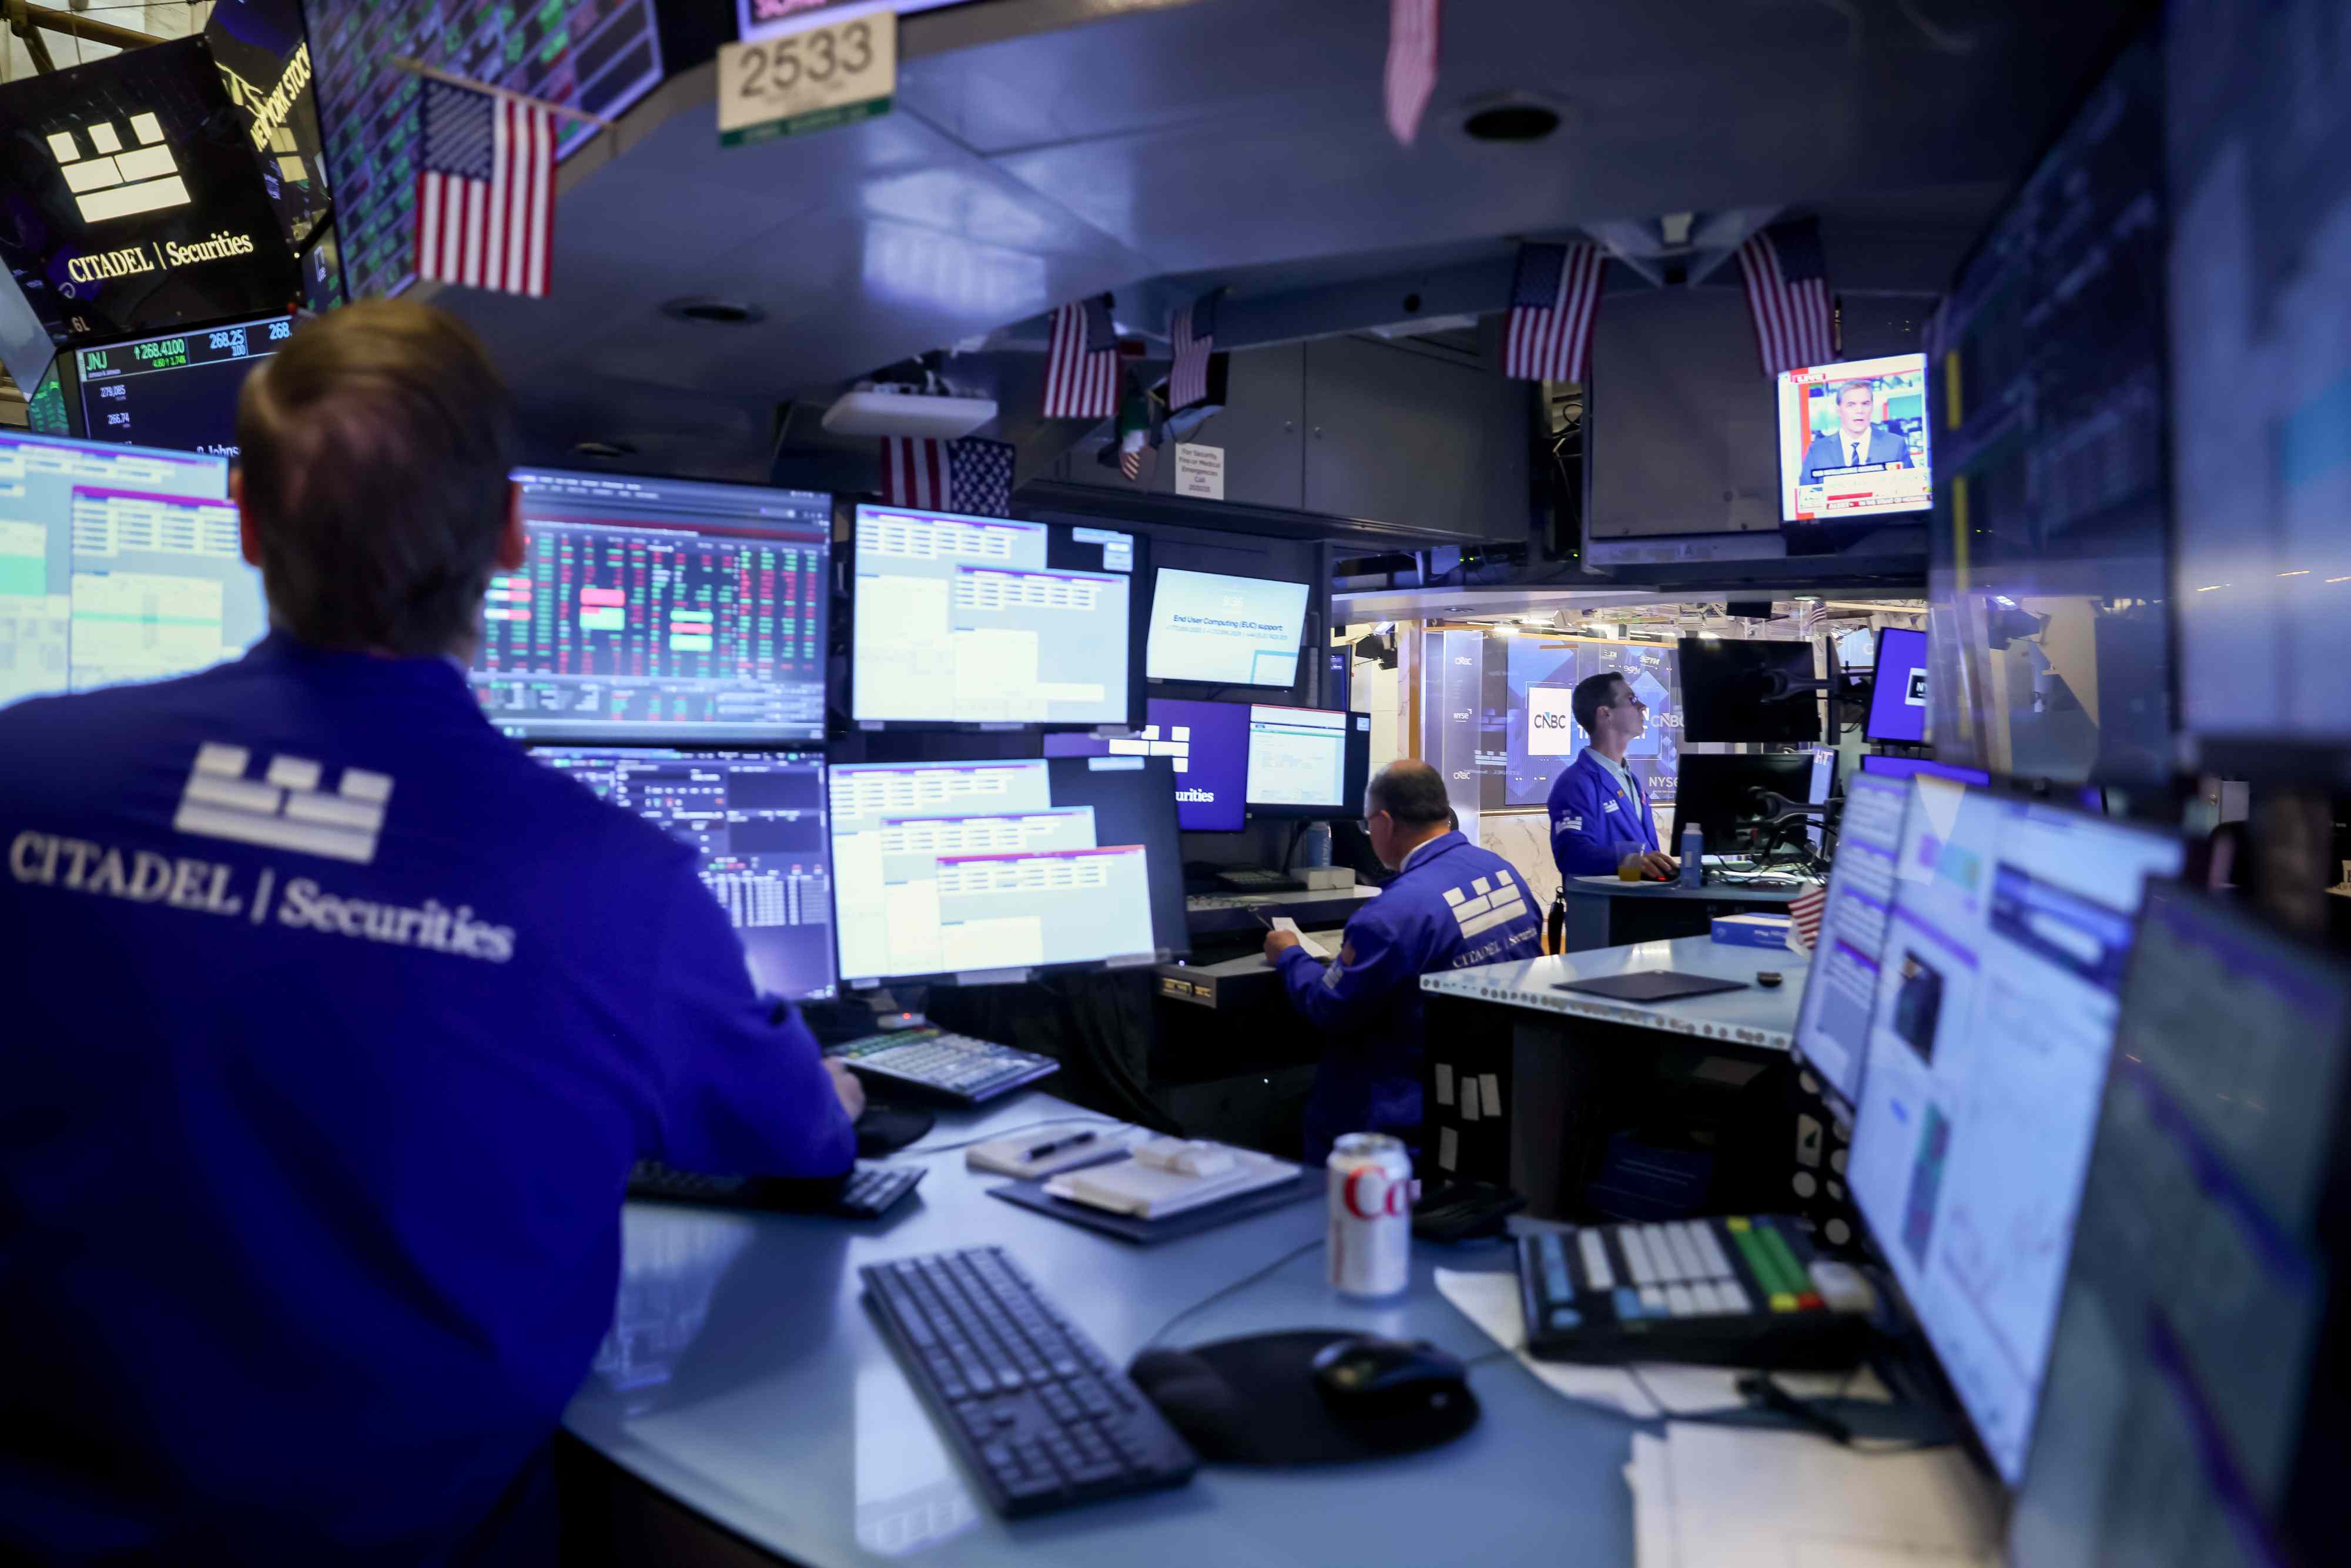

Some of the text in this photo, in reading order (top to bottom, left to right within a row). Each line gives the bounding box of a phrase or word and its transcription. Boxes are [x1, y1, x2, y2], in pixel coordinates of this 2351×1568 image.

[739, 21, 872, 98] 2533
[68, 246, 154, 283] CITADEL
[165, 230, 254, 267] Securities
[209, 329, 245, 349] 268.25
[86, 339, 186, 371] JNJ 268.4100
[1203, 618, 1238, 628] Computing
[1534, 712, 1566, 729] CNBC
[9, 830, 516, 964] CITADEL Securities
[1453, 941, 1502, 968] CITADEL
